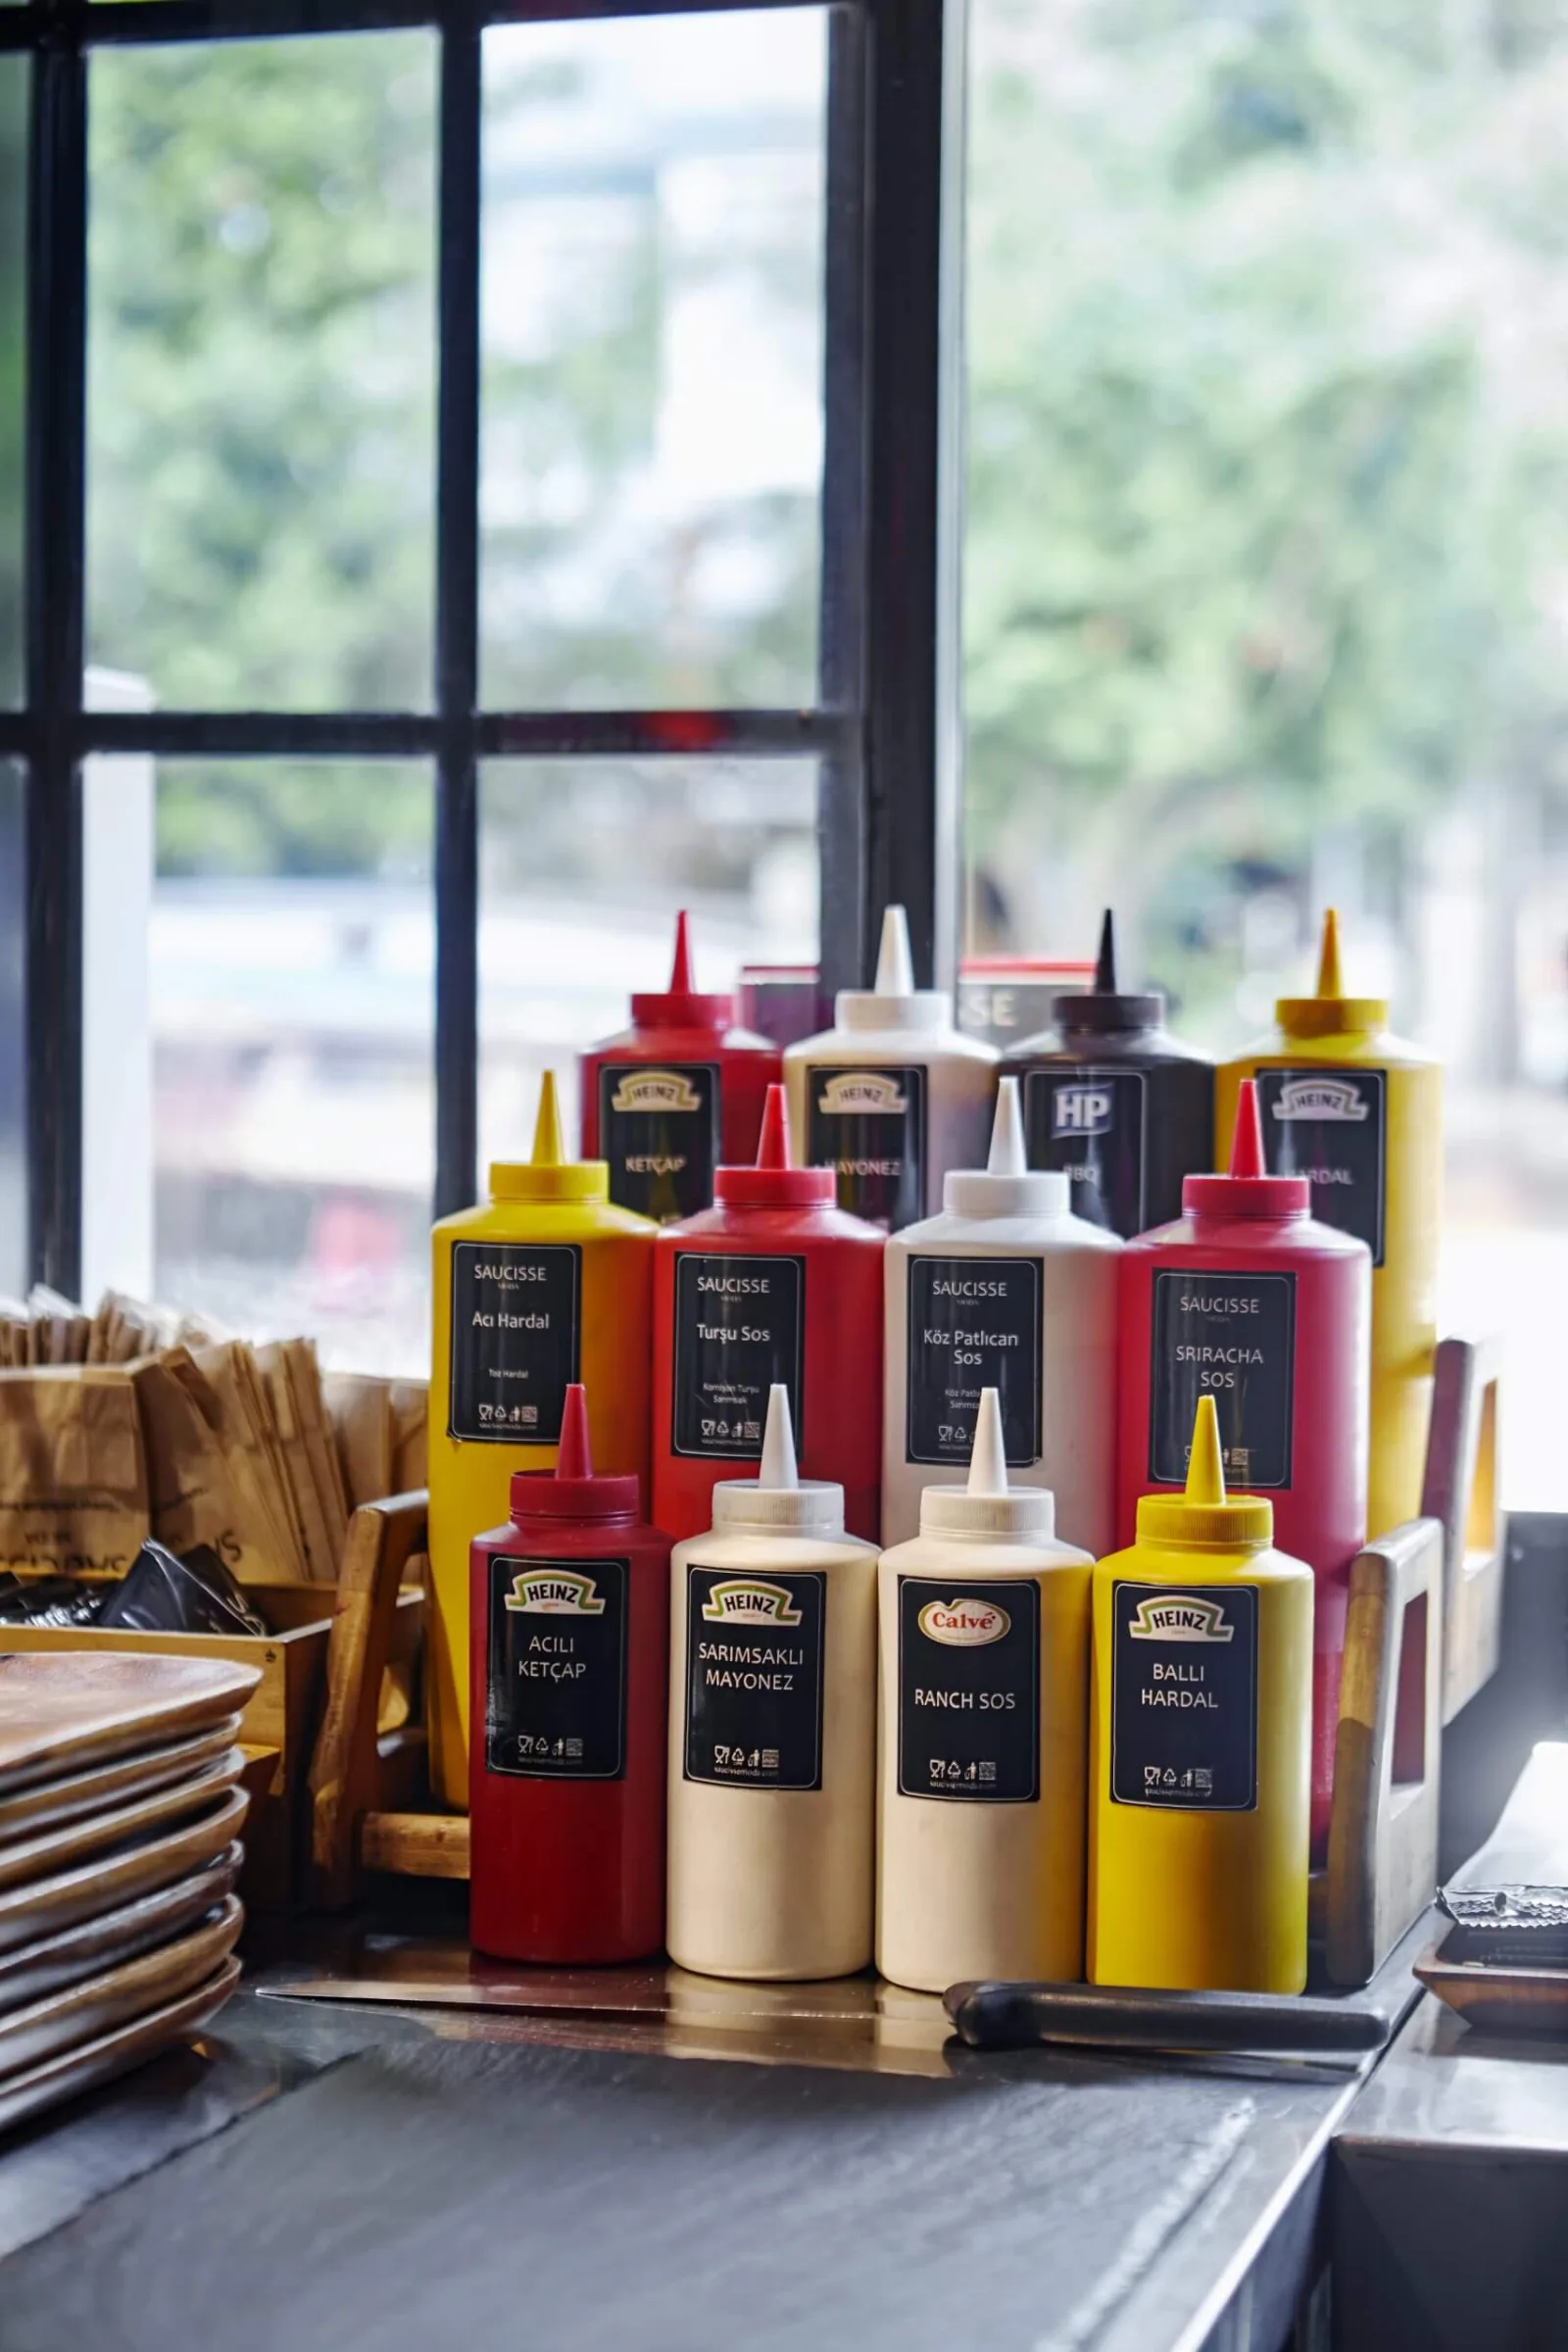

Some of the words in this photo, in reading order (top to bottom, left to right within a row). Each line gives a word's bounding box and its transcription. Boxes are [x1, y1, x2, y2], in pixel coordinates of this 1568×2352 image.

[631, 1086, 676, 1102] HEINZ
[839, 1086, 884, 1103] HEINZ
[1294, 1093, 1344, 1109] HEINZ
[1055, 1092, 1110, 1128] HP
[473, 1264, 548, 1281] SAUCISSE
[697, 1276, 770, 1294] SAUCISSE
[932, 1280, 1008, 1297] SAUCISSE
[1180, 1296, 1260, 1314] SAUCISSE
[498, 1313, 550, 1329] Hardal
[696, 1324, 737, 1345] Turşu
[741, 1326, 770, 1343] Sos
[923, 1329, 951, 1346] Köz
[954, 1330, 1019, 1347] Patlıcan
[954, 1349, 983, 1365] Sos
[1176, 1346, 1264, 1364] SRIRACHA
[1200, 1371, 1235, 1389] SOS
[527, 1584, 579, 1603] HEINZ
[723, 1593, 776, 1615] HEINZ
[932, 1611, 994, 1630] Calvé
[1152, 1610, 1206, 1631] HEINZ
[528, 1636, 574, 1653] ACILI
[699, 1642, 804, 1666] SARIMSAKLI
[518, 1661, 586, 1684] KETÇAP
[706, 1669, 794, 1691] MAYONEZ
[1152, 1663, 1204, 1682] BALLI
[914, 1689, 974, 1709] RANCH
[979, 1692, 1016, 1710] SOS
[1142, 1689, 1219, 1708] HARDAL
